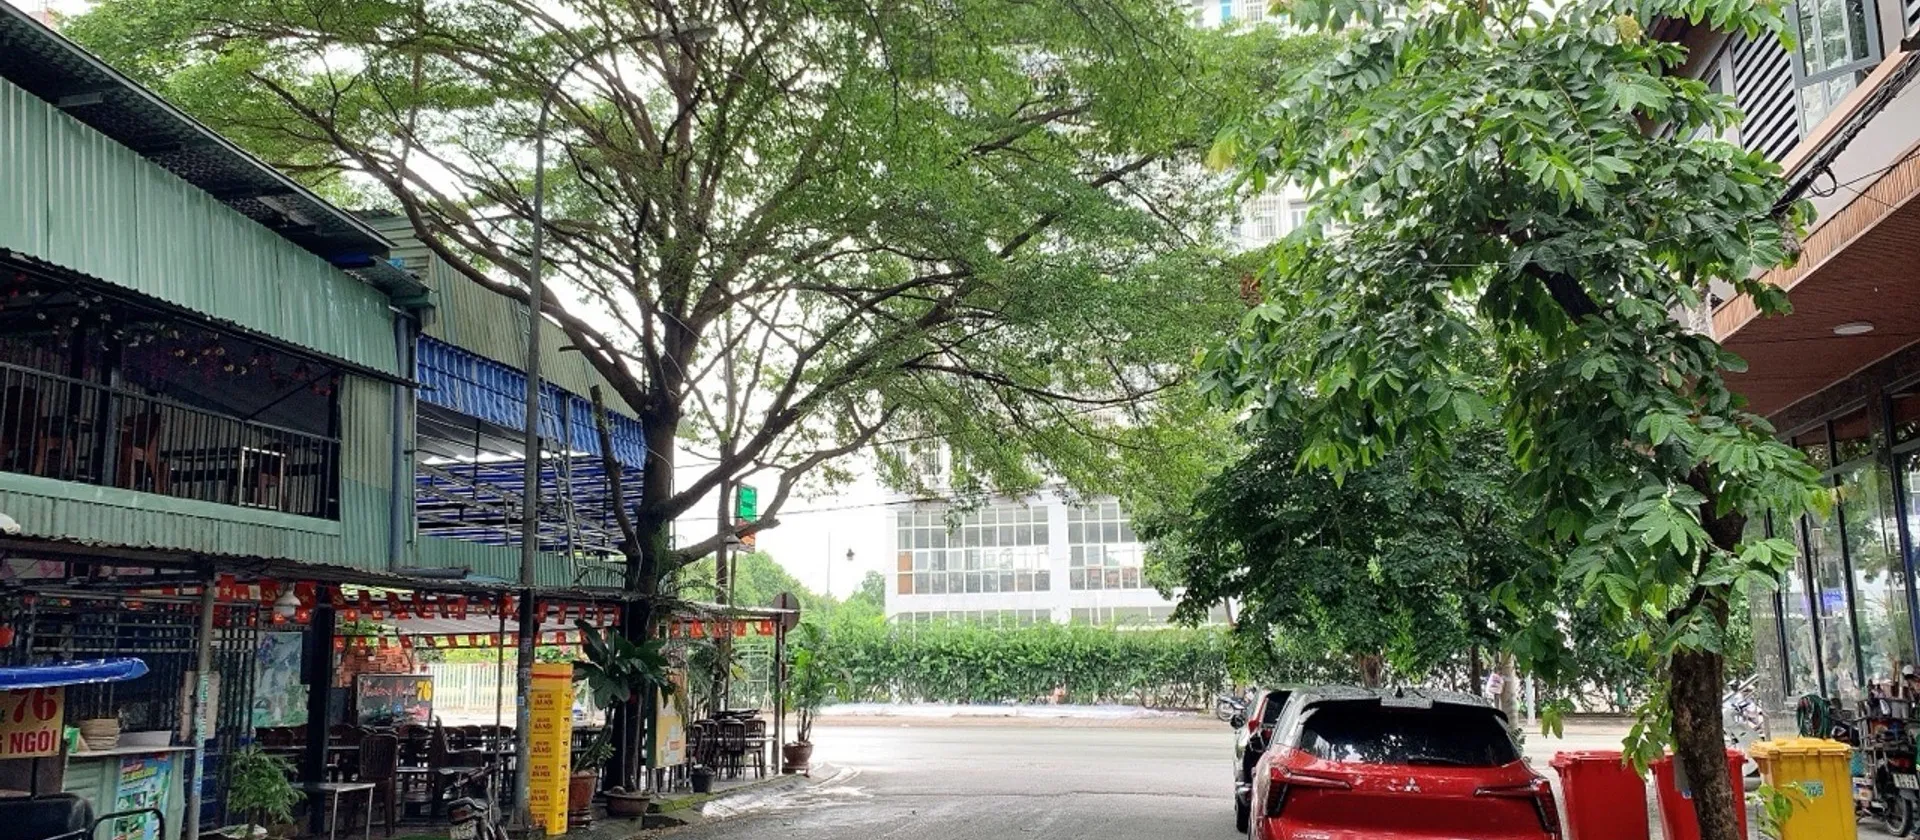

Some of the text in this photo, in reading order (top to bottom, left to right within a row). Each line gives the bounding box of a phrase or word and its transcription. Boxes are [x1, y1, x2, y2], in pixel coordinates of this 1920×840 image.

[417, 680, 432, 701] 76
[10, 688, 57, 723] 76
[9, 725, 57, 754] NGÓI
